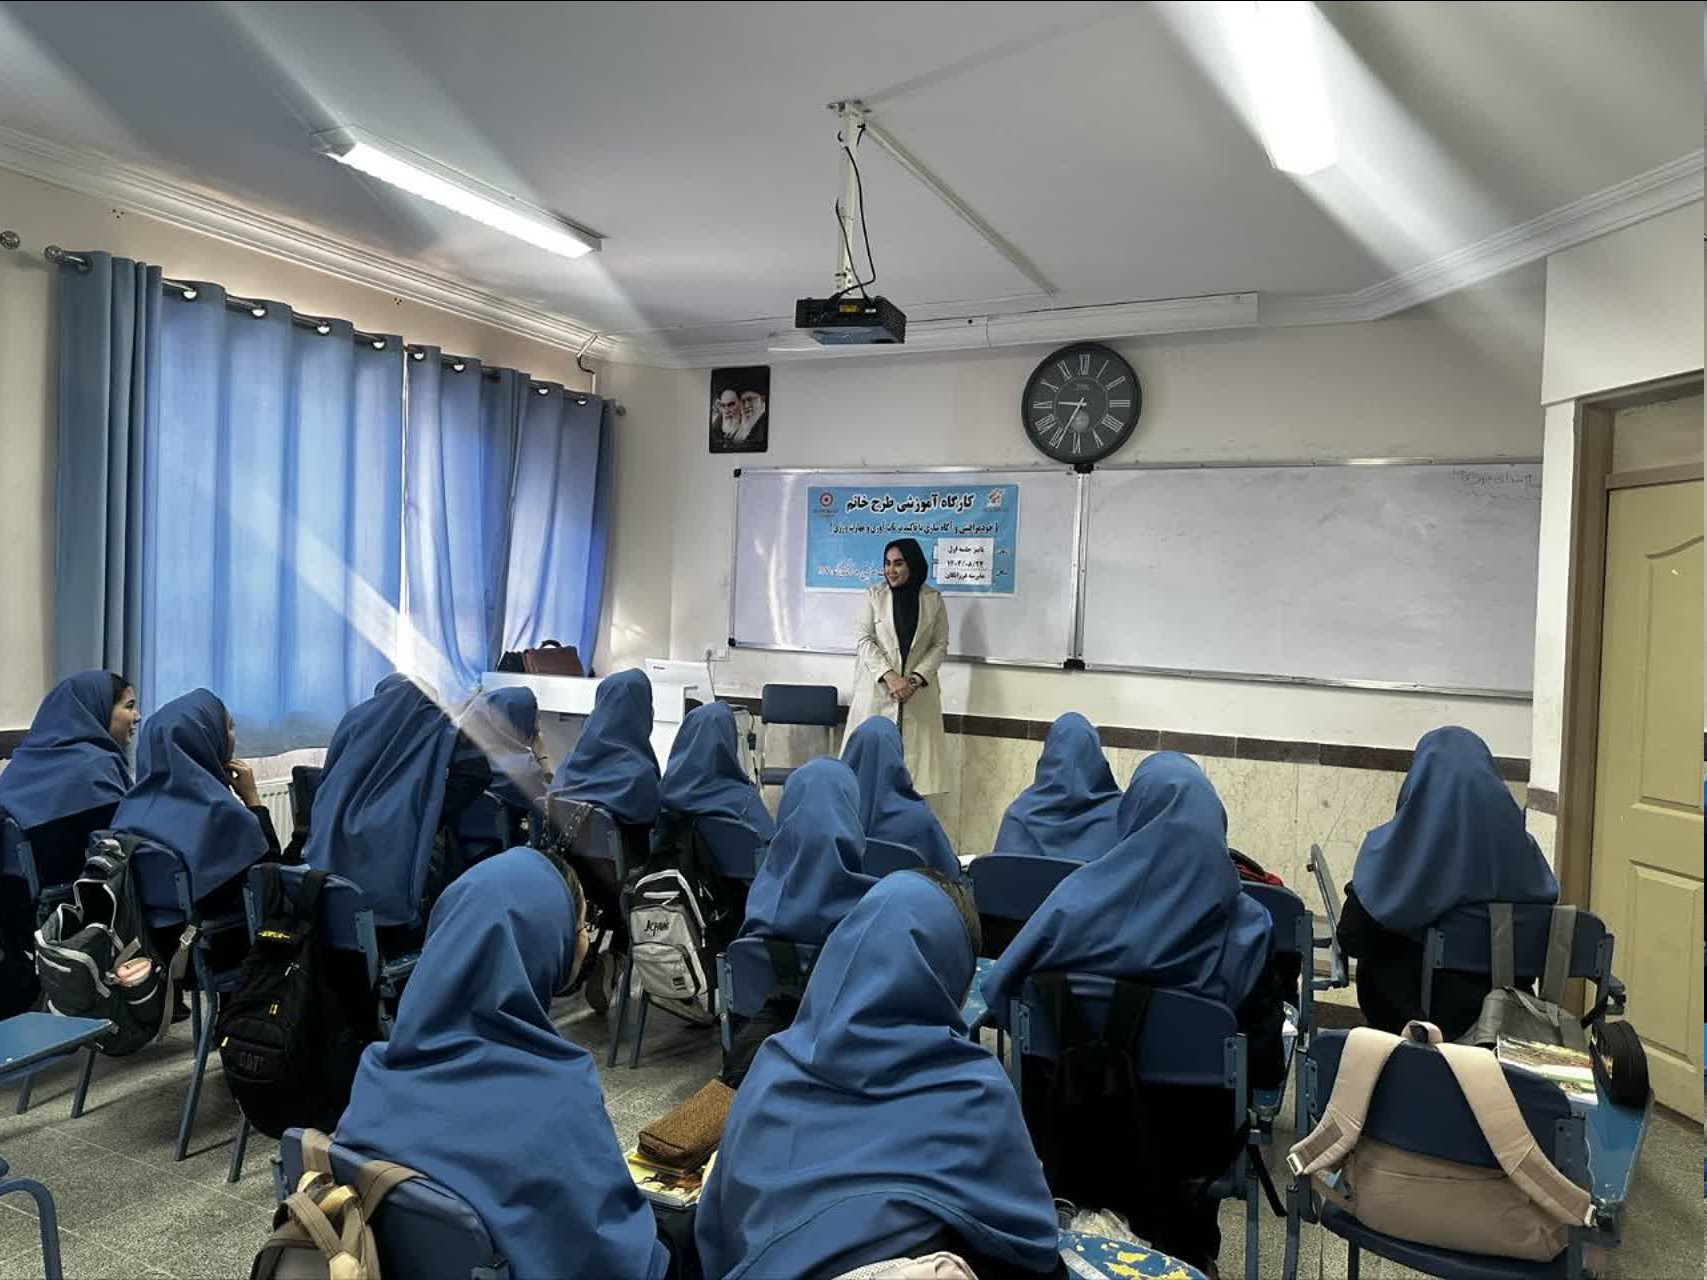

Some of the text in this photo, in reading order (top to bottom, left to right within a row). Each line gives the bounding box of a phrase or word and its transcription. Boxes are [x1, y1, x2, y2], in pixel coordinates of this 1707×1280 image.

[870, 495, 894, 513] طرح
[896, 493, 939, 514] آموزشی
[940, 494, 975, 513] کارگاه
